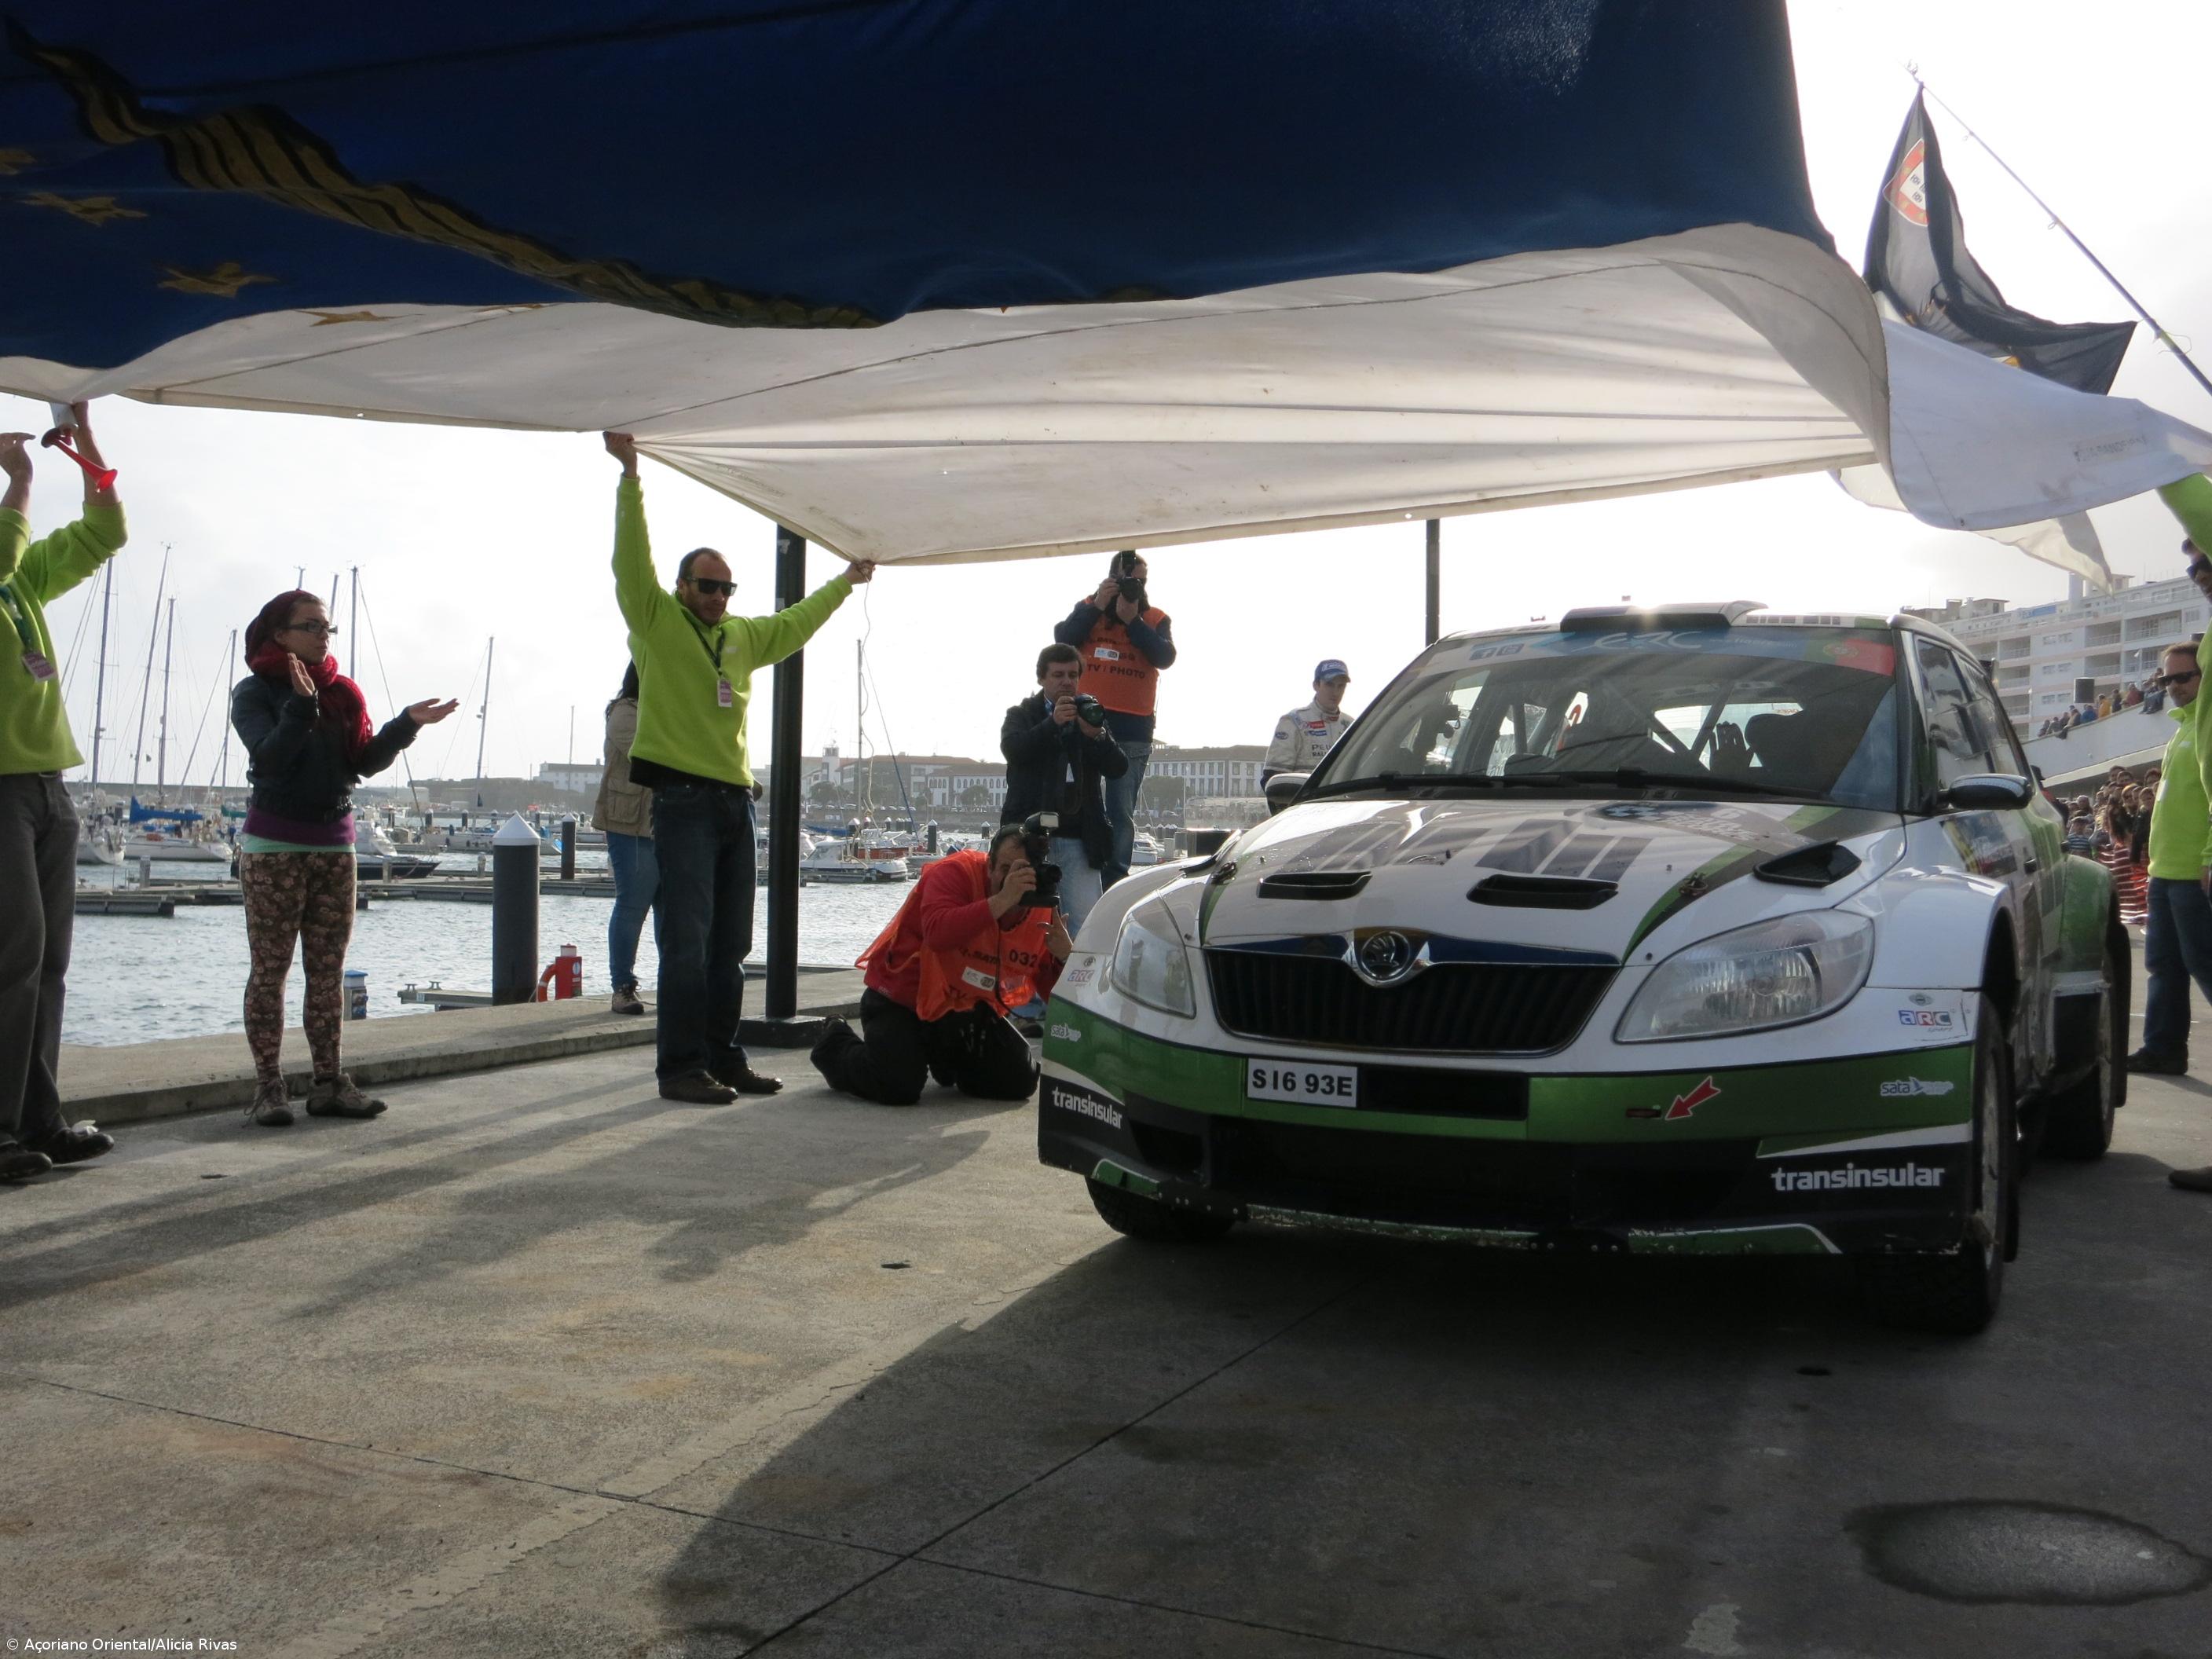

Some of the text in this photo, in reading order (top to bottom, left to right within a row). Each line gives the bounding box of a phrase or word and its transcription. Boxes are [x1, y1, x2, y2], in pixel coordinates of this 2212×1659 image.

[1109, 665, 1145, 679] PHOTO
[1009, 949, 1038, 968] 032
[1305, 1073, 1353, 1097] 93E
[1881, 1082, 1910, 1094] sata
[1051, 1086, 1123, 1130] transinsular
[1771, 1162, 1946, 1191] transinsular
